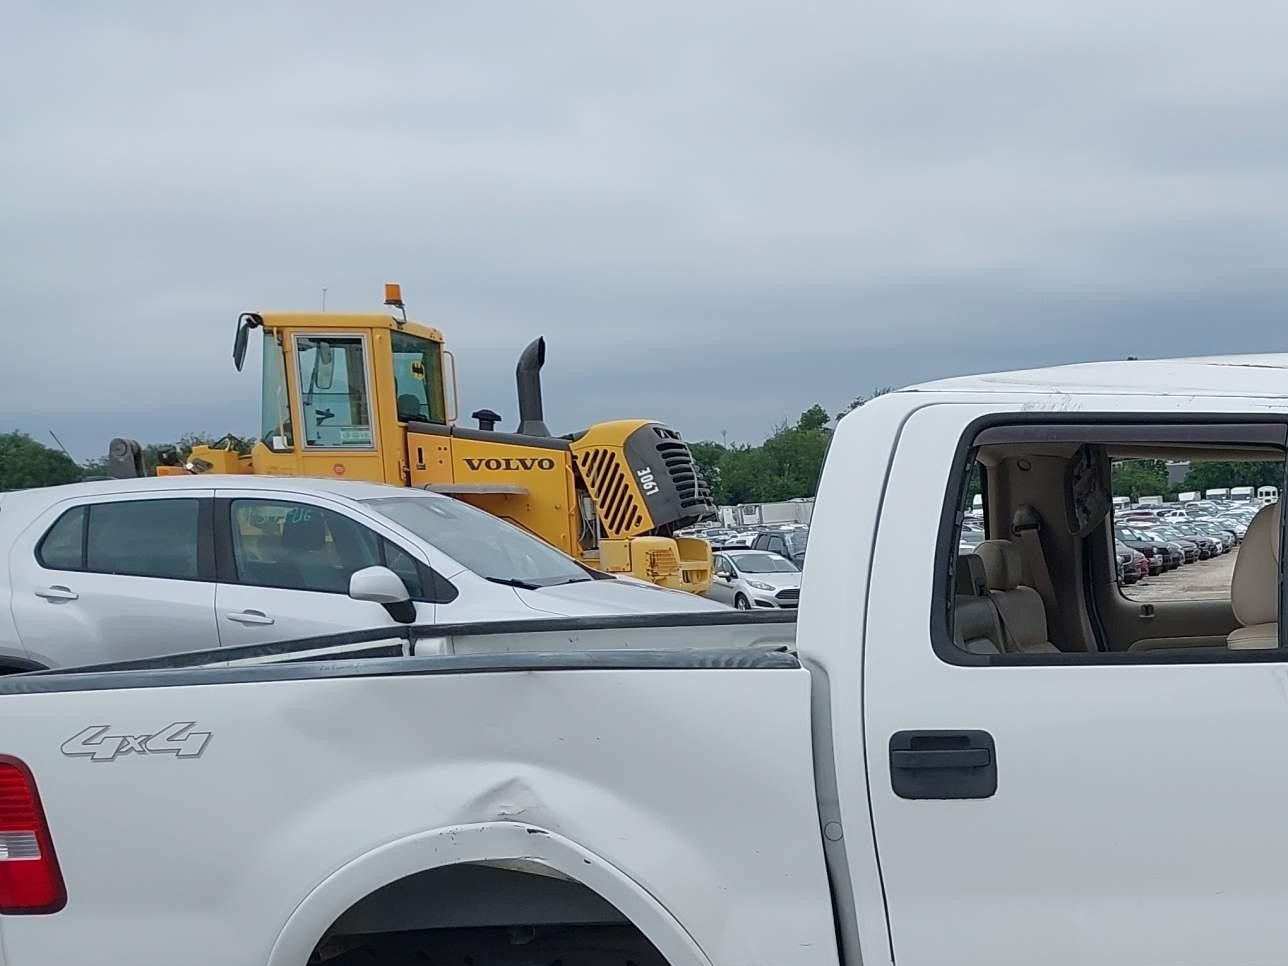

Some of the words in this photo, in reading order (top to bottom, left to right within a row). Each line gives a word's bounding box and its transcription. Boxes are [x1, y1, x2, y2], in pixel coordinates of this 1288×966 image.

[463, 457, 555, 471] VOLVO
[636, 466, 660, 496] L90E
[60, 721, 213, 762] 4x4
